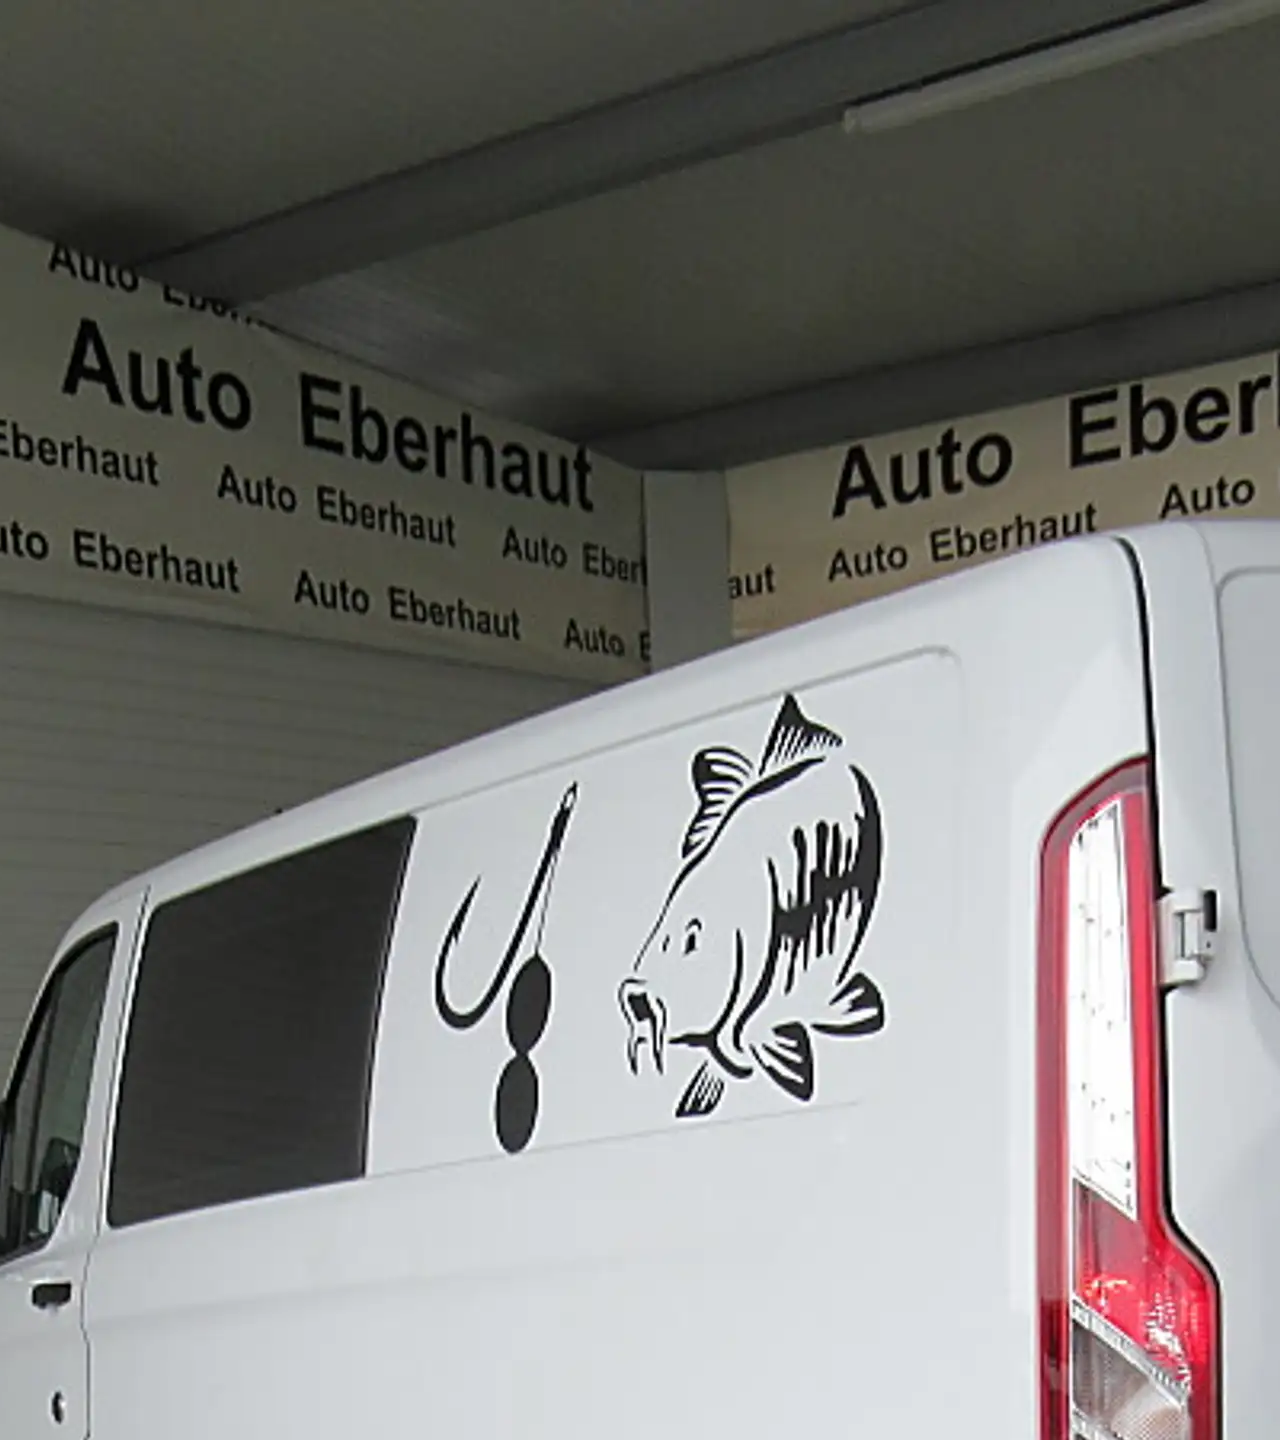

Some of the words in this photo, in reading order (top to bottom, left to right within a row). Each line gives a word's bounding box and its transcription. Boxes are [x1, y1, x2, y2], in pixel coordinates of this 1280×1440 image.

[62, 318, 252, 430] Auto
[299, 372, 594, 512] Eberhaut
[218, 465, 297, 512] Auto
[317, 486, 457, 548] Eberhaut
[832, 428, 1013, 518] Auto
[1159, 474, 1256, 520] Auto
[73, 530, 240, 594] Eberhaut
[502, 526, 567, 569] Auto
[828, 541, 910, 582] Auto
[930, 504, 1098, 563] Eberhaut
[294, 570, 370, 615] Auto
[389, 587, 521, 641] Eberhaut
[564, 619, 625, 657] Auto
